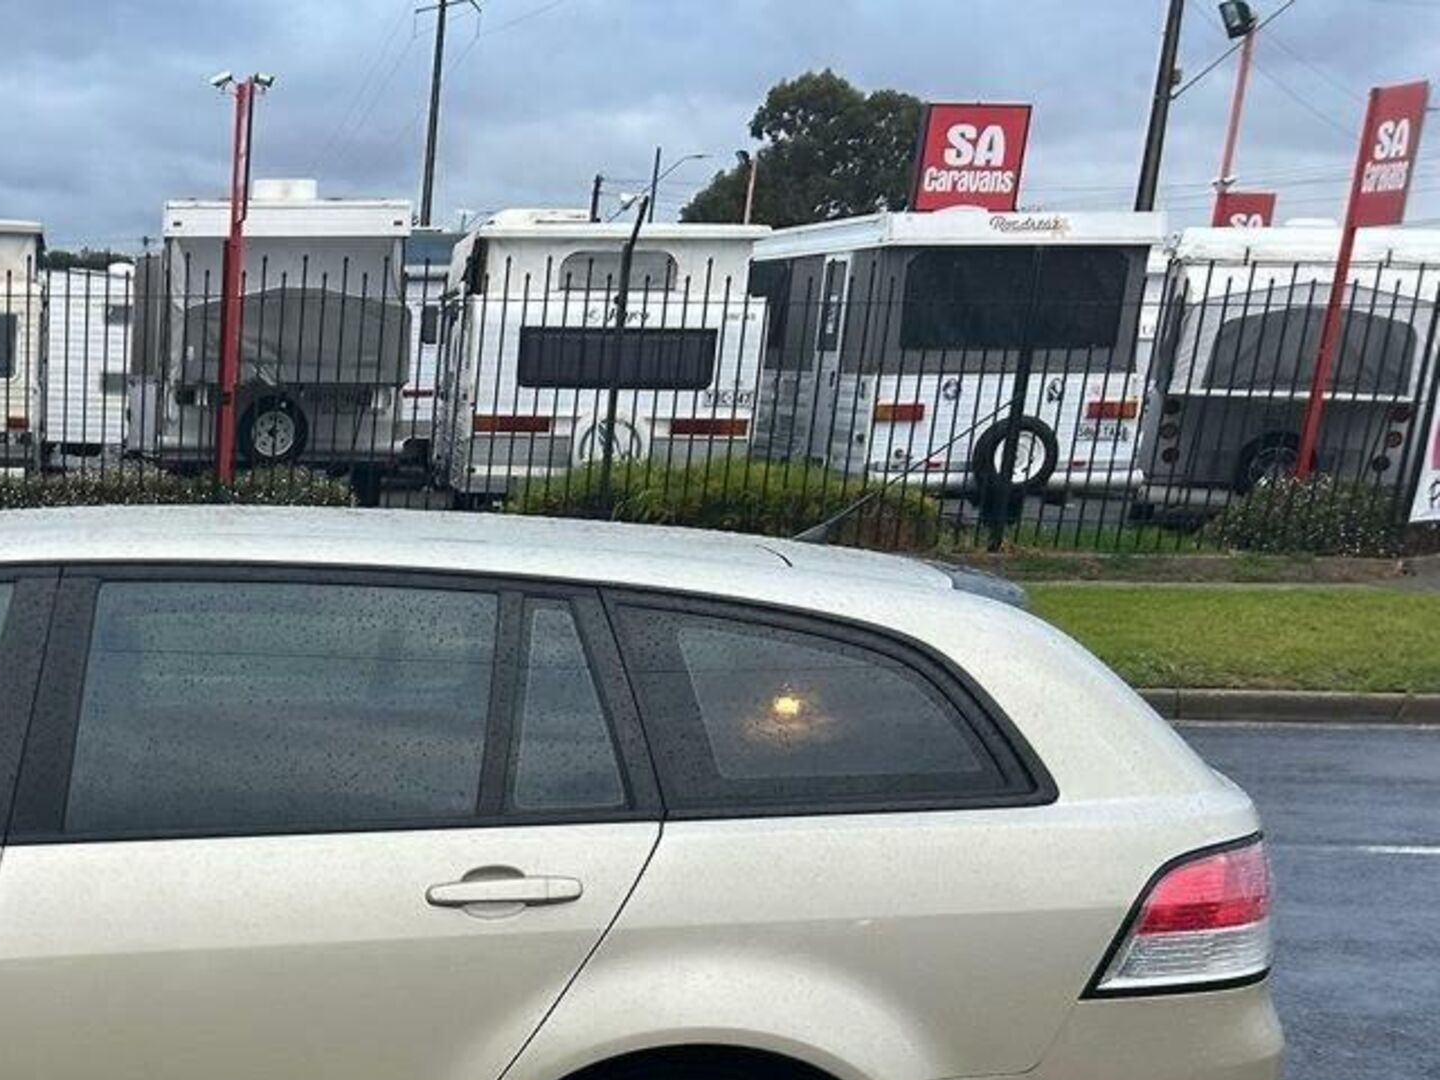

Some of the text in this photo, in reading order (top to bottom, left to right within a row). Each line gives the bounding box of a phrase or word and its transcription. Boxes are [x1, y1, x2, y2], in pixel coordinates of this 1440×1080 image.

[943, 124, 1006, 167] SA
[1374, 118, 1410, 160] SA
[923, 166, 1015, 194] Caravans
